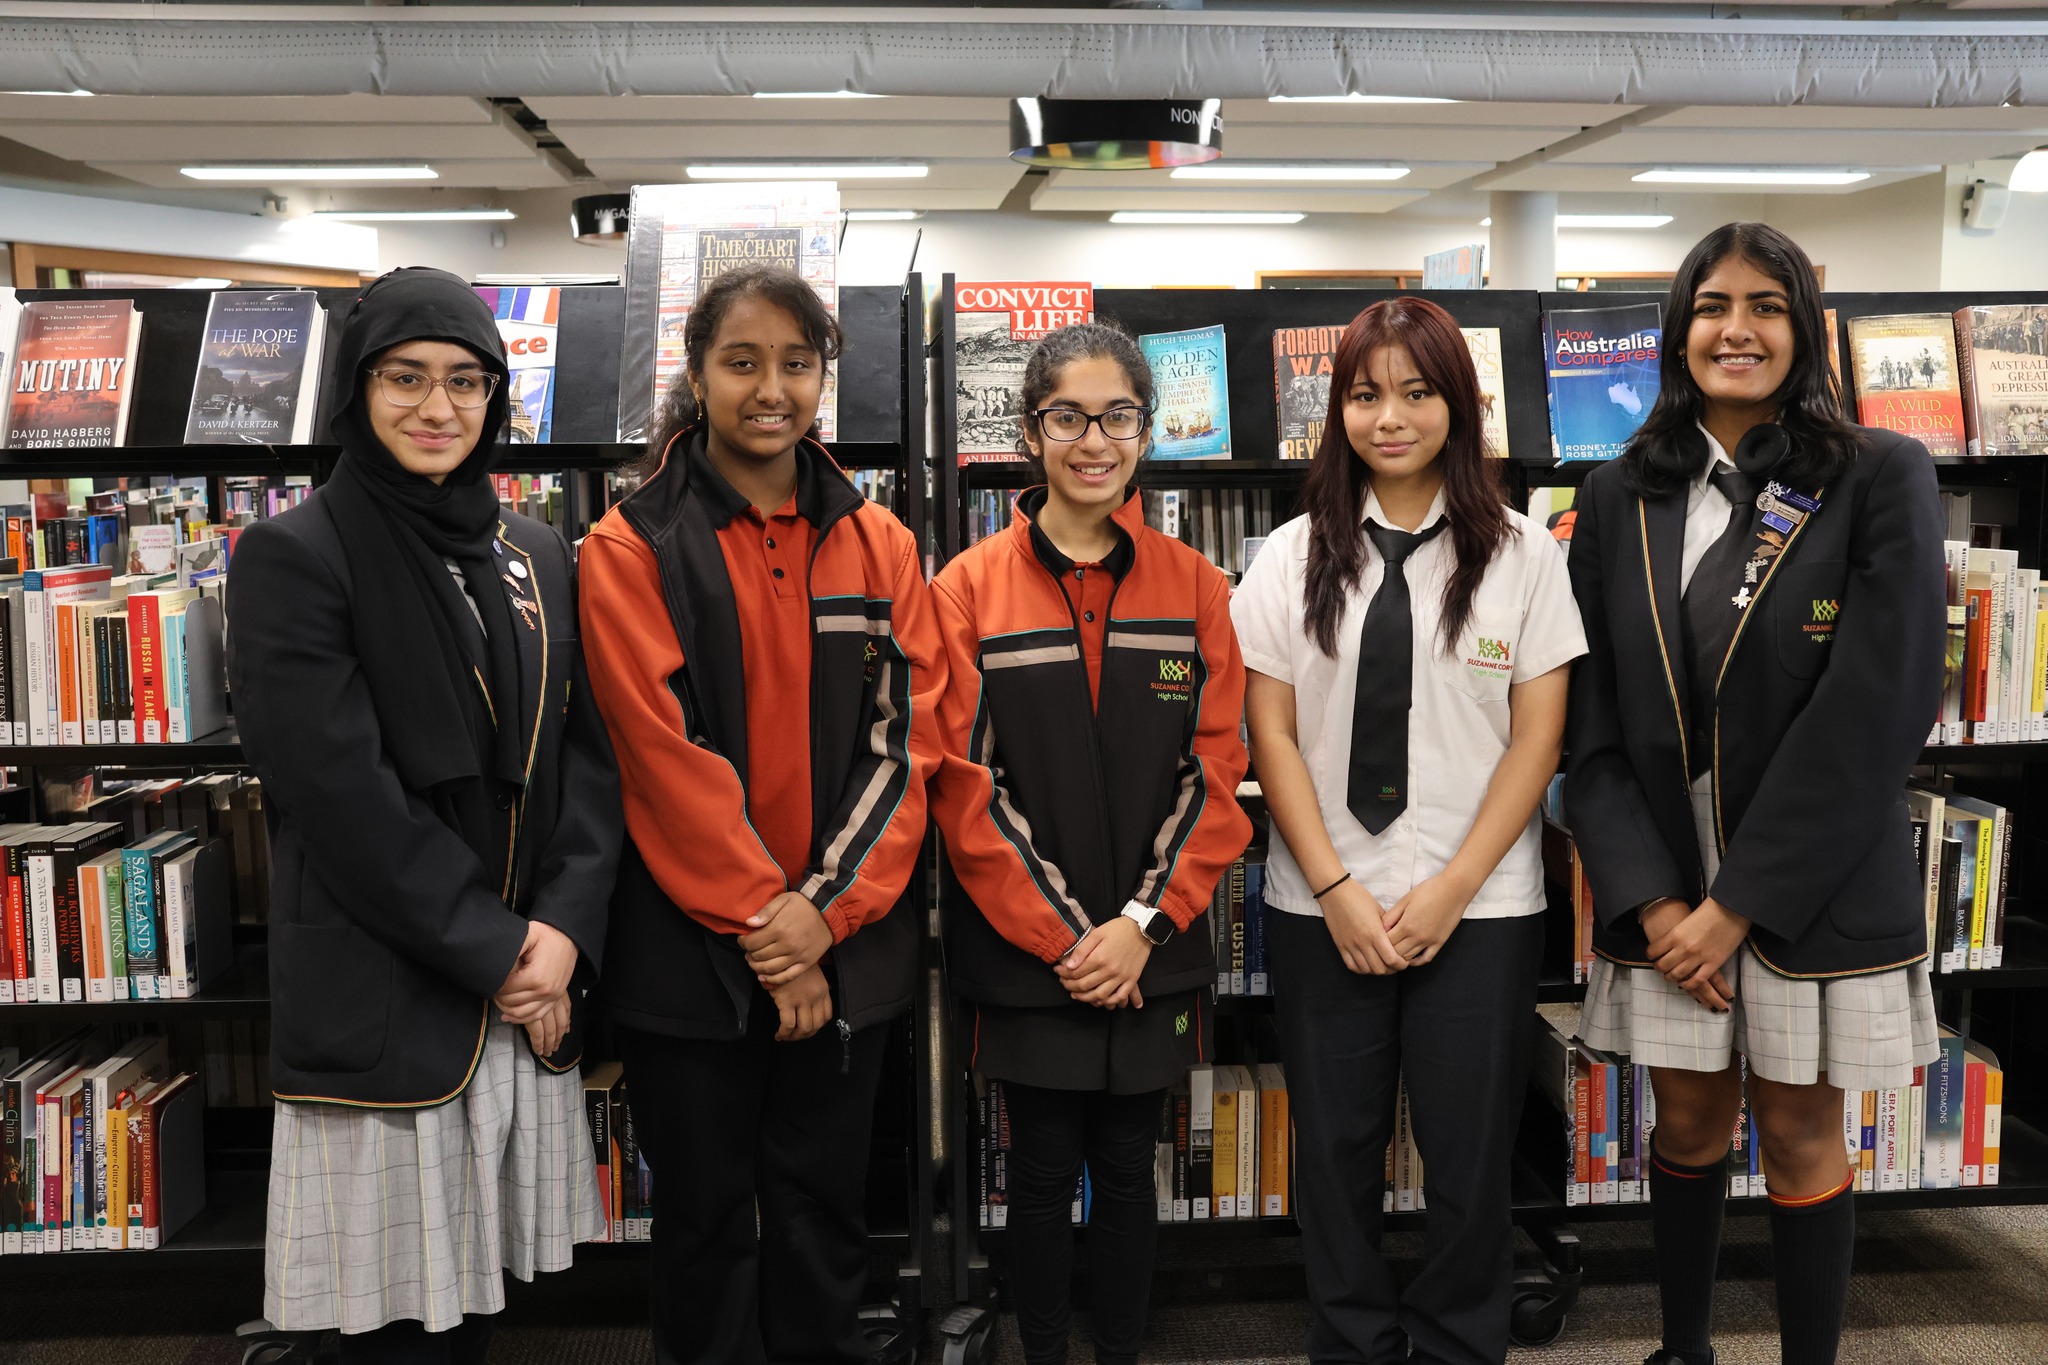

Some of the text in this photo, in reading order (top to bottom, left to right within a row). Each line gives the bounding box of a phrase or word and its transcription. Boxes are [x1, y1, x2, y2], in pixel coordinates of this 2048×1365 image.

[957, 287, 1089, 309] CONVICT
[1014, 310, 1083, 332] LIFE
[212, 328, 298, 343] THE POPE
[1012, 332, 1022, 340] IN
[1149, 331, 1215, 346] HUGH THOMAS
[1556, 329, 1593, 341] How
[1556, 333, 1657, 354] Australia
[241, 344, 282, 358] WAR
[1148, 348, 1219, 368] GOLDEN
[1556, 349, 1658, 366] Compares
[16, 358, 124, 393] MUTINY
[1168, 365, 1200, 379] AGE
[1178, 379, 1212, 391] SPANISH
[1884, 399, 1942, 412] A WILD
[198, 420, 279, 429] DAVID KERTZER
[1875, 414, 1956, 431] HISTORY
[12, 427, 111, 439] DAVID HAGBERG
[27, 439, 63, 449] BORIS
[68, 438, 111, 447] GINDIN
[964, 455, 980, 463] AN
[1566, 451, 1593, 459] ROSS
[1989, 580, 2000, 658] AUSTRALIA GREAT
[1812, 634, 1826, 643] High
[141, 637, 153, 673] RUSSIA
[1467, 658, 1498, 669] SUZANNE
[143, 676, 152, 686] IN
[1473, 669, 1507, 680] High School
[1150, 683, 1180, 691] SUZANNE
[1158, 693, 1171, 702] High
[1914, 827, 1922, 847] Plots
[1996, 816, 2005, 843] Sydney
[2003, 825, 2012, 851] Captain
[1933, 838, 1941, 862] Greatest
[1980, 838, 1988, 866] Knowledge
[1931, 864, 1939, 884] PEOPLE
[169, 875, 177, 905] ORHAN
[58, 896, 69, 946] IN POWER
[68, 877, 81, 963] THE BOLSHEVIKS
[1956, 910, 1965, 947] BATAVIA
[1975, 917, 1983, 936] History
[111, 906, 124, 958] VIKINGS
[1940, 1048, 1949, 1124] PETER FITZSIMONS
[84, 1088, 92, 1118] CHINESE
[1578, 1092, 1586, 1106] CITY
[6, 1088, 19, 1144] inside China
[1578, 1108, 1586, 1122] LOST
[1621, 1097, 1630, 1122] Phillip
[143, 1111, 151, 1129] THE
[595, 1101, 604, 1142] Vietnam
[1178, 1098, 1187, 1151] 102 MINUTES
[1846, 1112, 1855, 1134] EUREKA
[1578, 1131, 1587, 1152] FOUND
[1622, 1123, 1630, 1151] District
[112, 1130, 120, 1188] Emperor Citizen
[143, 1132, 151, 1167] RULER'S
[98, 1170, 106, 1201] Stories
